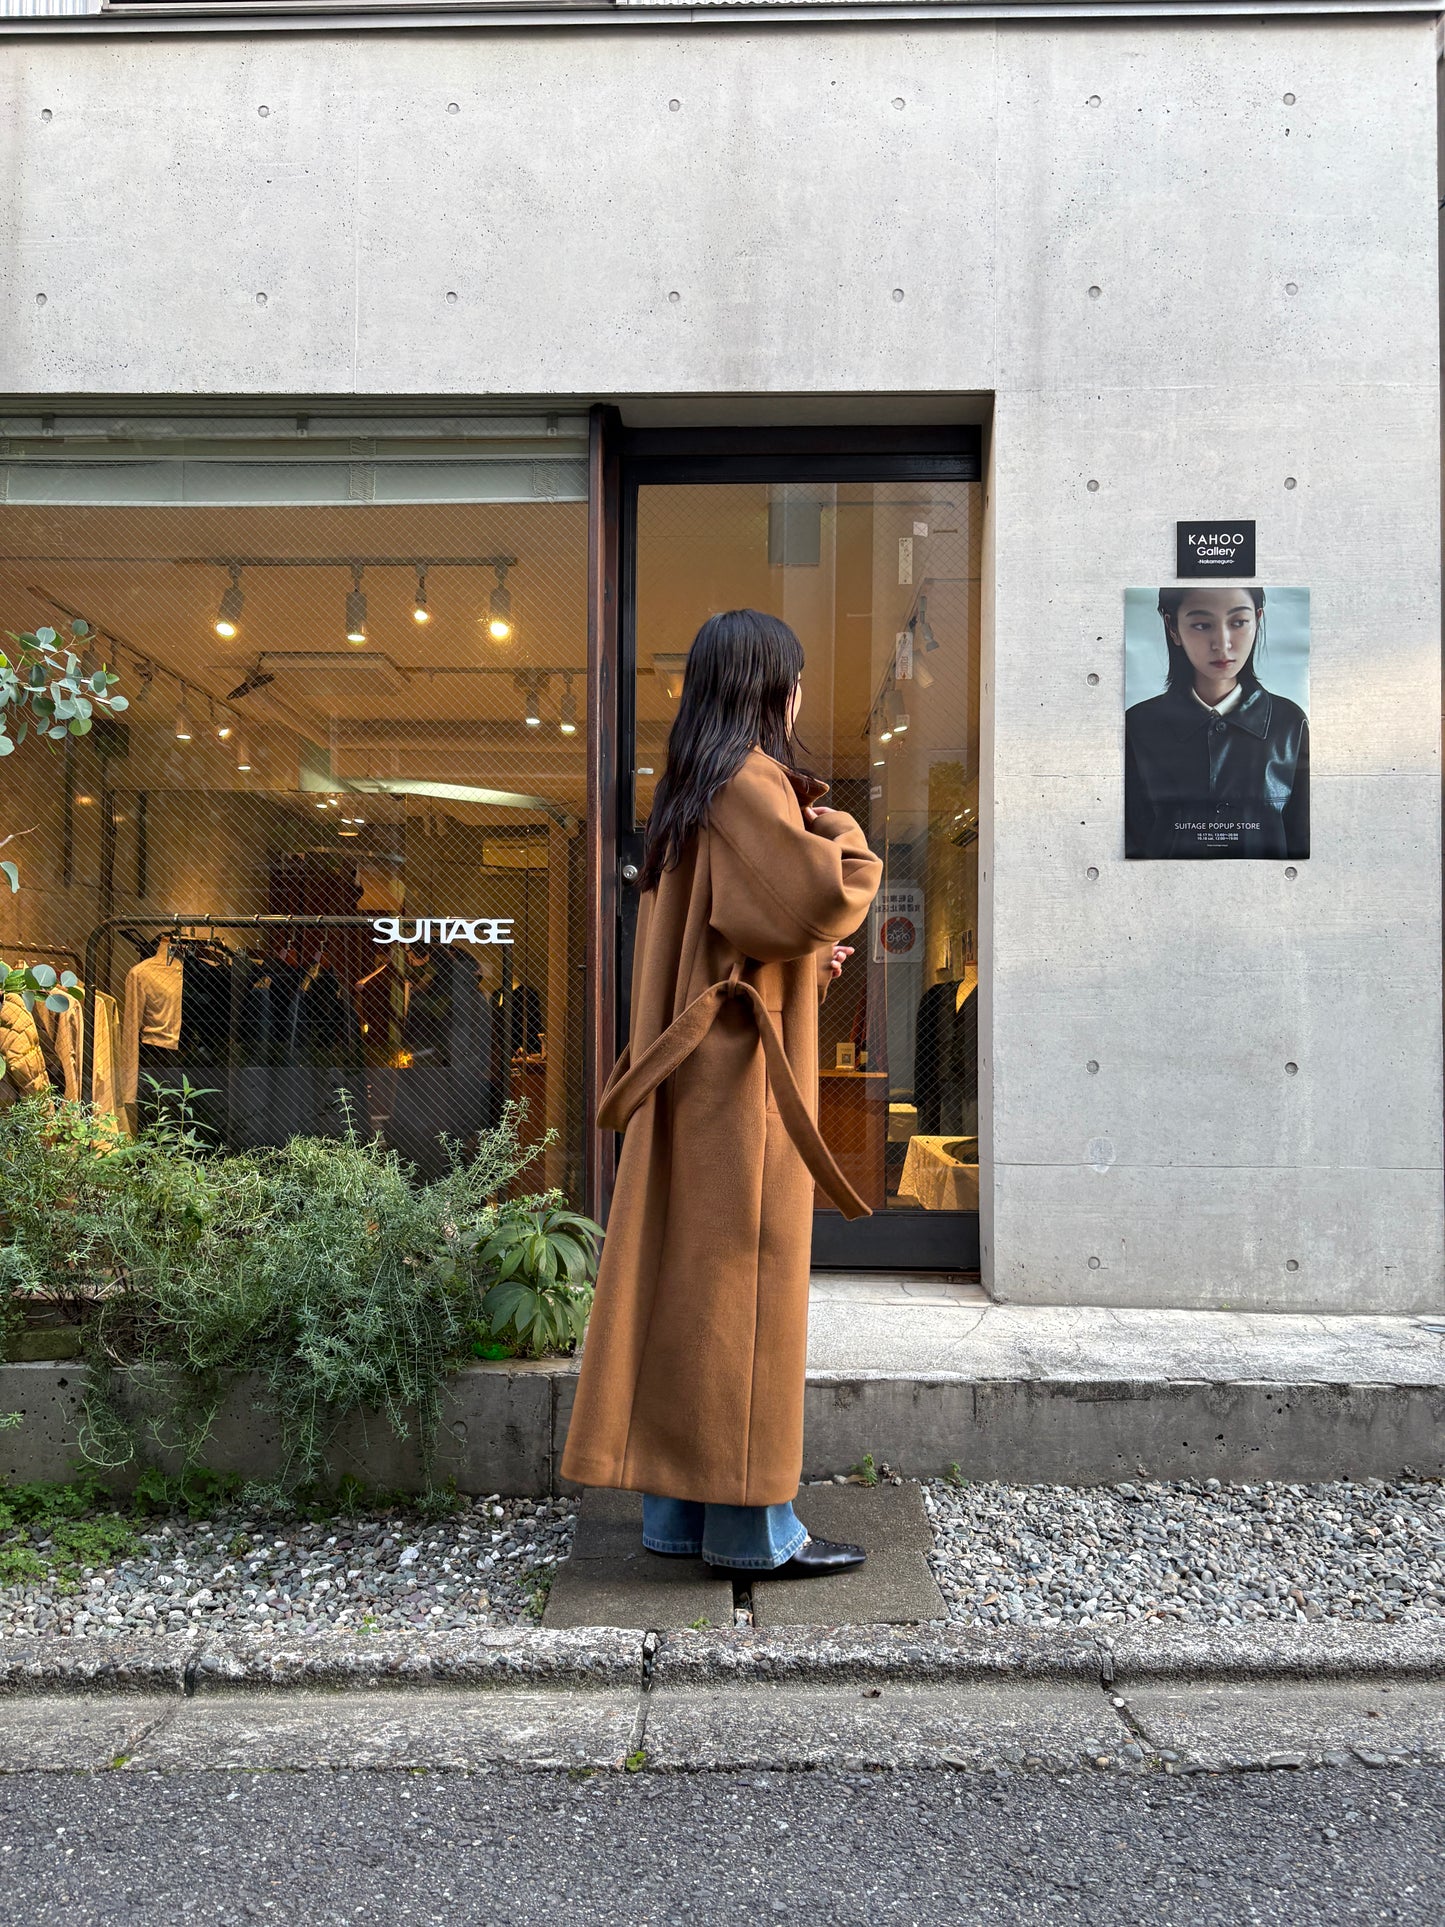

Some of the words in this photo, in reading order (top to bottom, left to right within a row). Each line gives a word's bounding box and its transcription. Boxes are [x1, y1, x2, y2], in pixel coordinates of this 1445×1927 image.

[1188, 533, 1244, 545] KAHOO
[1196, 546, 1236, 557] Gallery
[372, 918, 515, 944] SUITAGE
